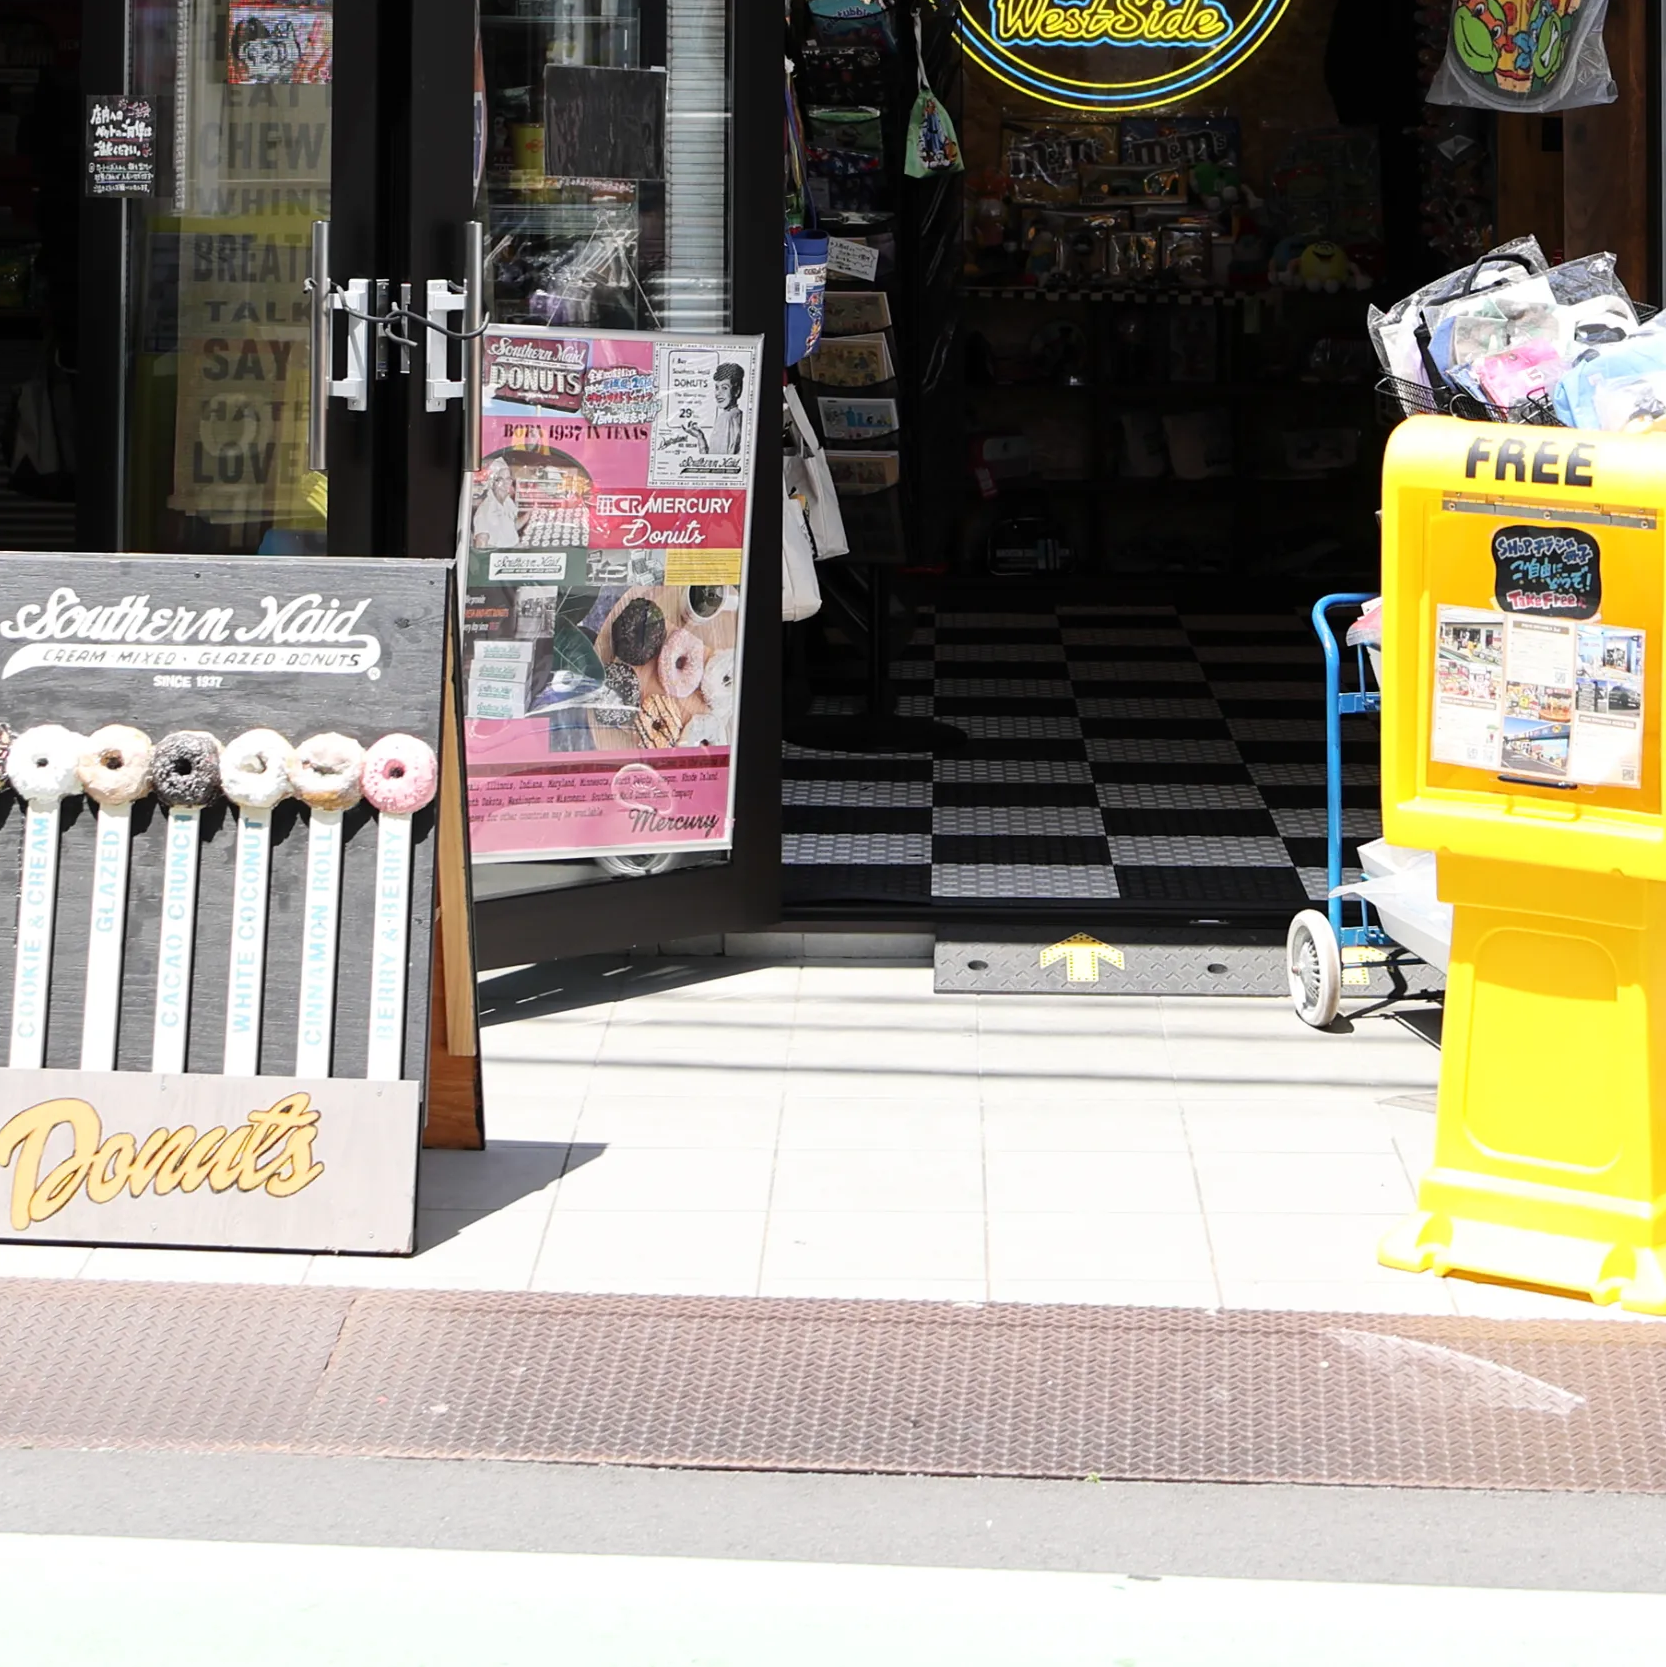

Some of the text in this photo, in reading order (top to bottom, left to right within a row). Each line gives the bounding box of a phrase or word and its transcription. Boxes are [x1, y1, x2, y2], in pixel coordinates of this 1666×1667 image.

[201, 120, 328, 171] CHEW
[204, 300, 311, 322] TALK
[203, 338, 291, 382] SAY
[487, 337, 585, 365] Southern Maid
[490, 363, 583, 396] DONUTS
[674, 379, 708, 388] DONUTS
[503, 422, 649, 441] BORN 1937 IN TEXAS
[193, 441, 303, 484] LOVE
[1464, 436, 1596, 488] FREE
[648, 497, 734, 514] MERCURY
[619, 518, 706, 546] Donuts
[0, 586, 373, 644] Southern Maid
[43, 649, 106, 663] CREAM
[198, 651, 276, 666] GLAZED
[285, 652, 362, 667] DONUTS
[153, 674, 224, 688] SINCE 1937
[628, 808, 720, 837] Mercury
[95, 830, 121, 933] GLAZED
[381, 830, 403, 918] BERRY
[16, 817, 50, 1039] COOKIE & CREAM
[160, 813, 193, 1028] CACAO CRUNCH
[233, 817, 263, 1033] WHITE COCONUT
[304, 828, 333, 1046] CINNAMON ROLL
[375, 952, 397, 1040] BERRY
